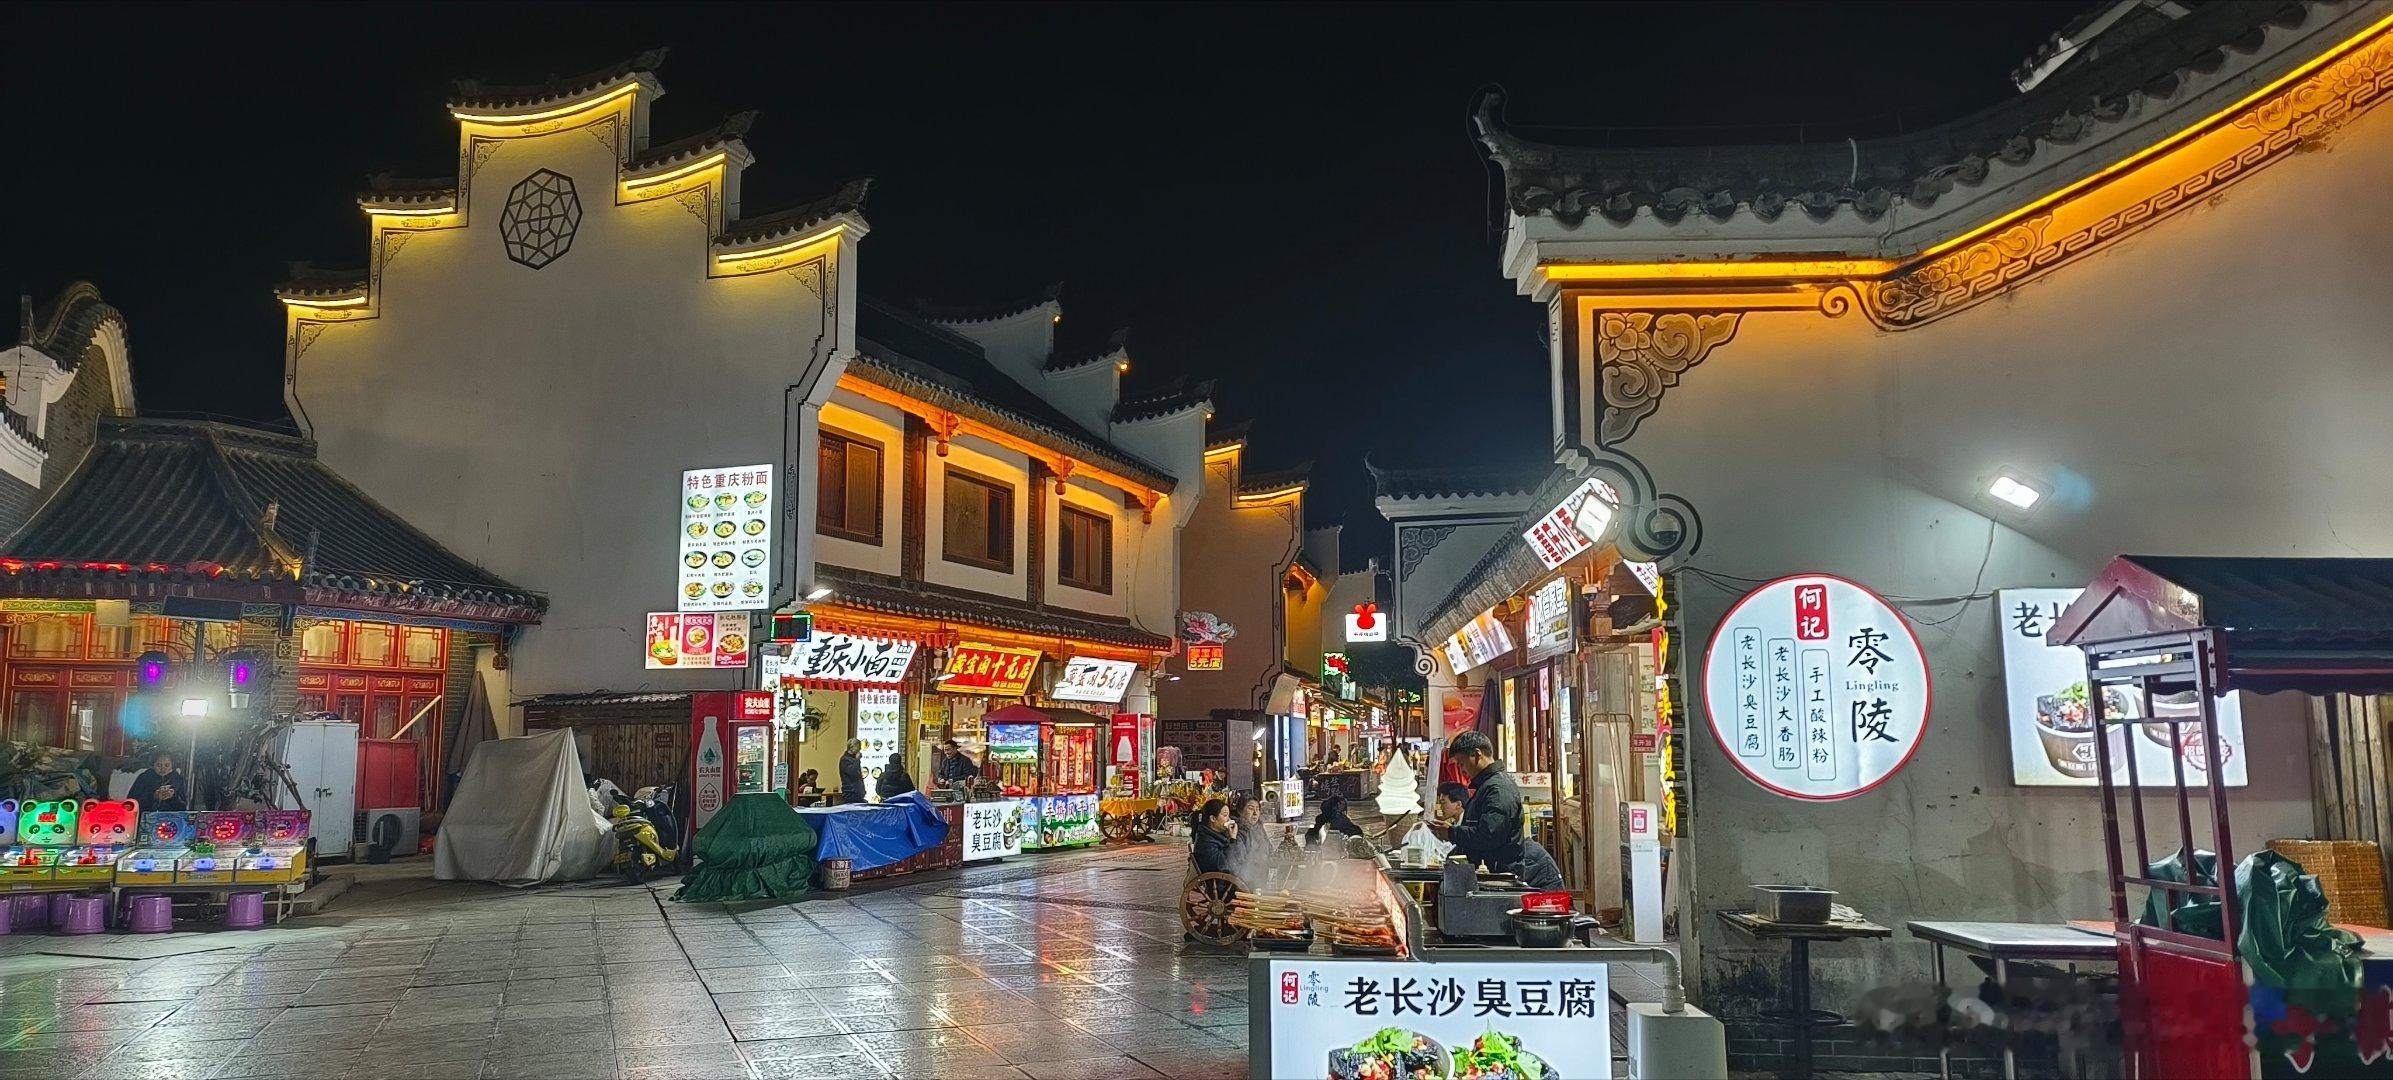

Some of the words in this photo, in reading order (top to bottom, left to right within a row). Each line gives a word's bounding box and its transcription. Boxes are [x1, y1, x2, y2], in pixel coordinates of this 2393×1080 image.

[687, 471, 768, 490] 特色重庆粉面
[1799, 588, 1825, 638] 何记
[803, 636, 893, 678] 重庆小面
[1740, 634, 1760, 751] 老长沙臭豆腐
[1846, 680, 1899, 692] Lingling
[1774, 645, 1795, 763] 老长沙大香肠
[1809, 666, 1829, 764] 手工酸辣粉
[972, 808, 1003, 830] 老长沙
[971, 831, 1003, 853] 臭豆腐
[1282, 974, 1298, 1004] 何记
[1300, 985, 1329, 994] Lingling
